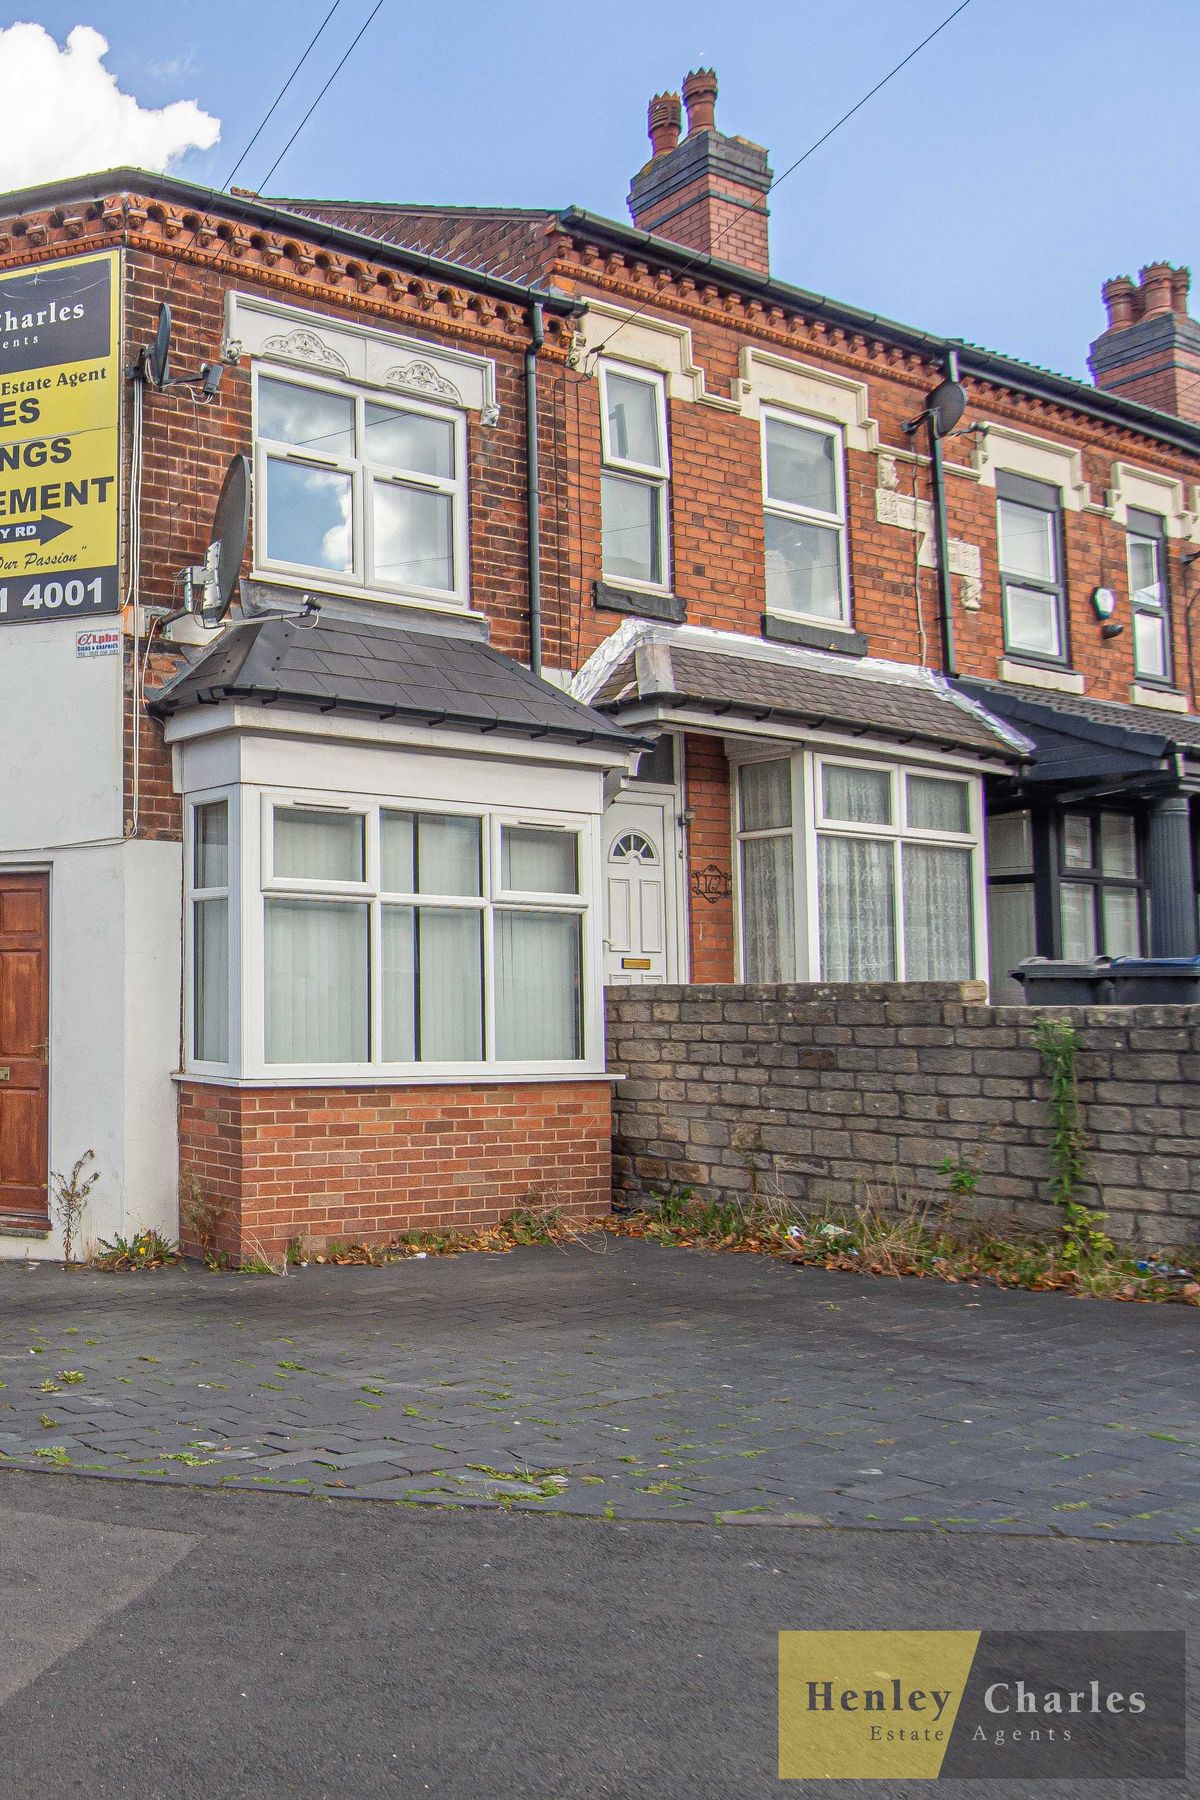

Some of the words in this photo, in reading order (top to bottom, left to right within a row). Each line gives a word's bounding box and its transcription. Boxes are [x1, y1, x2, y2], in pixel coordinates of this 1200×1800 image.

[1, 377, 52, 396] Estate
[56, 367, 107, 388] Agent
[15, 524, 37, 537] RD
[22, 577, 102, 611] 4001
